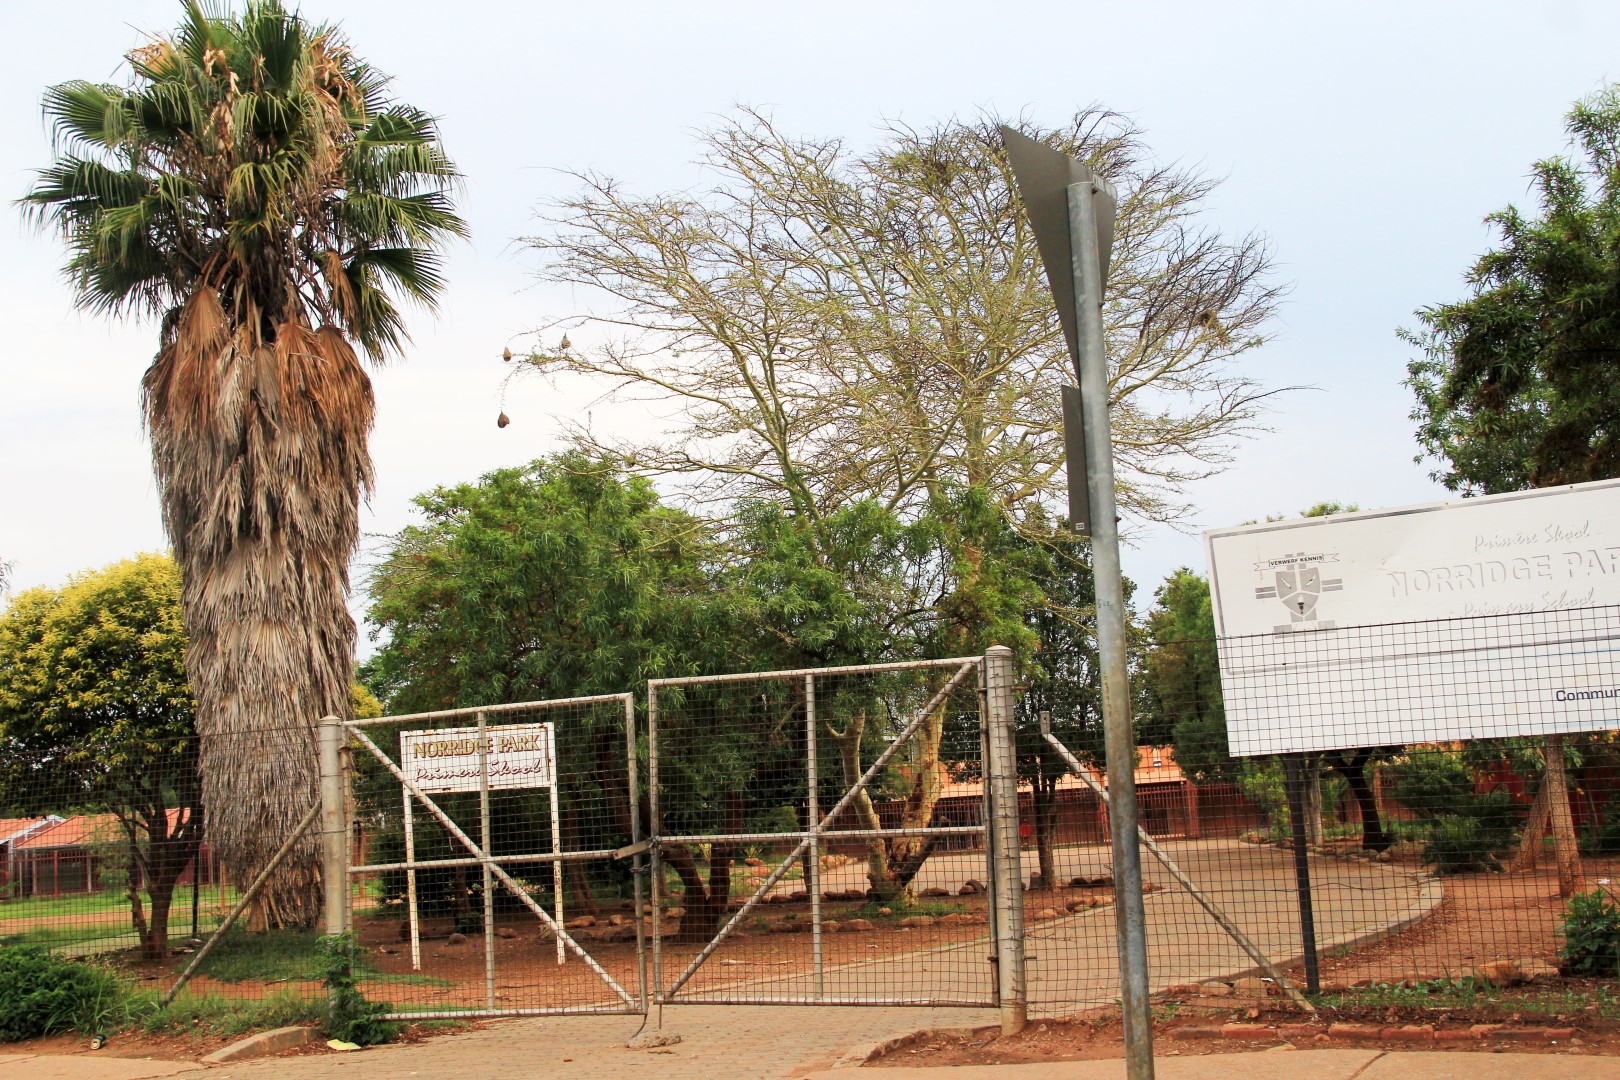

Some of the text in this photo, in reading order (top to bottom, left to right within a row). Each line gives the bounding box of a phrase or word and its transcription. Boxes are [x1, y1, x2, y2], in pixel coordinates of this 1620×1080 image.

[1270, 555, 1323, 566] VERWERF KENNIS
[1386, 555, 1553, 597] NORRIDGE
[1464, 587, 1596, 618] Primary School
[499, 734, 541, 754] PARK
[488, 758, 541, 777] Skool
